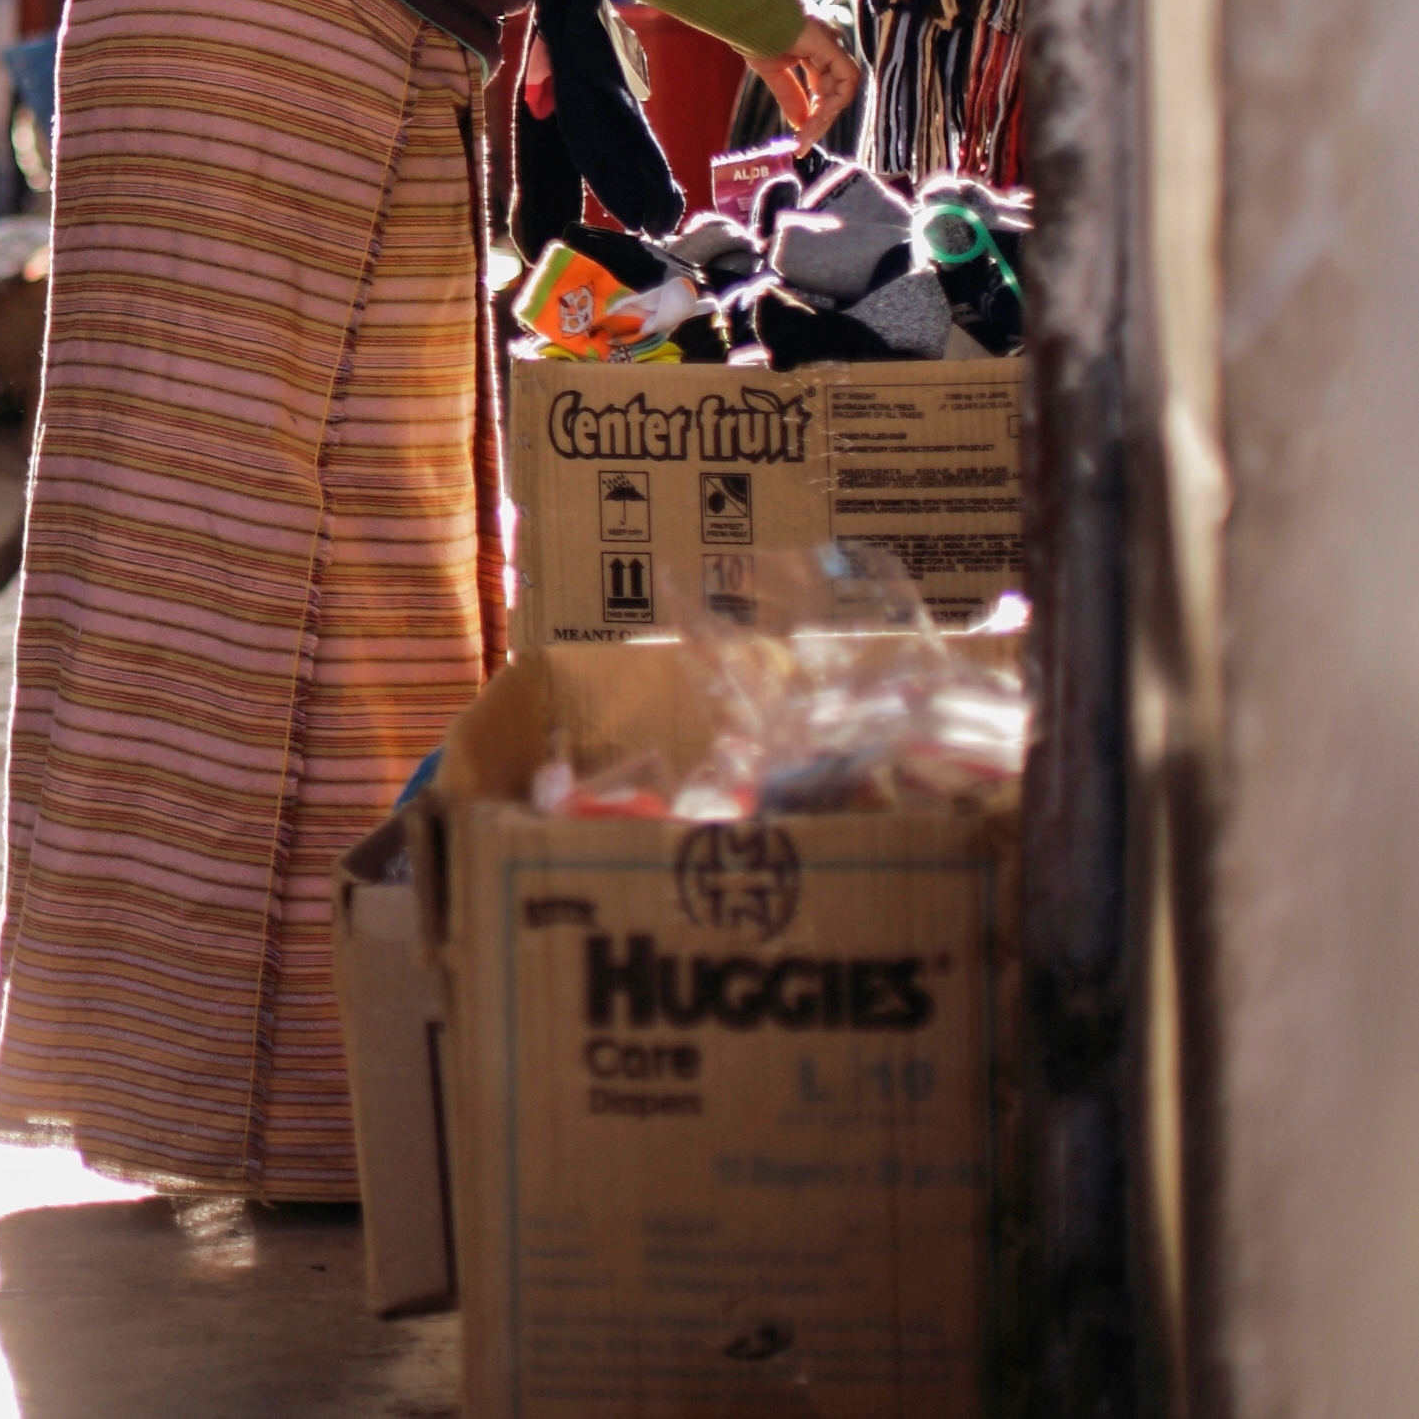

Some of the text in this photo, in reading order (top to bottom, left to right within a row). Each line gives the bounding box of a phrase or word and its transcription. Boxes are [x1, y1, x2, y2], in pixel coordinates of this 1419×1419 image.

[548, 386, 812, 464] Center fruit
[707, 530, 728, 538] FROM
[553, 629, 616, 641] MEANT
[585, 1039, 702, 1080] Care
